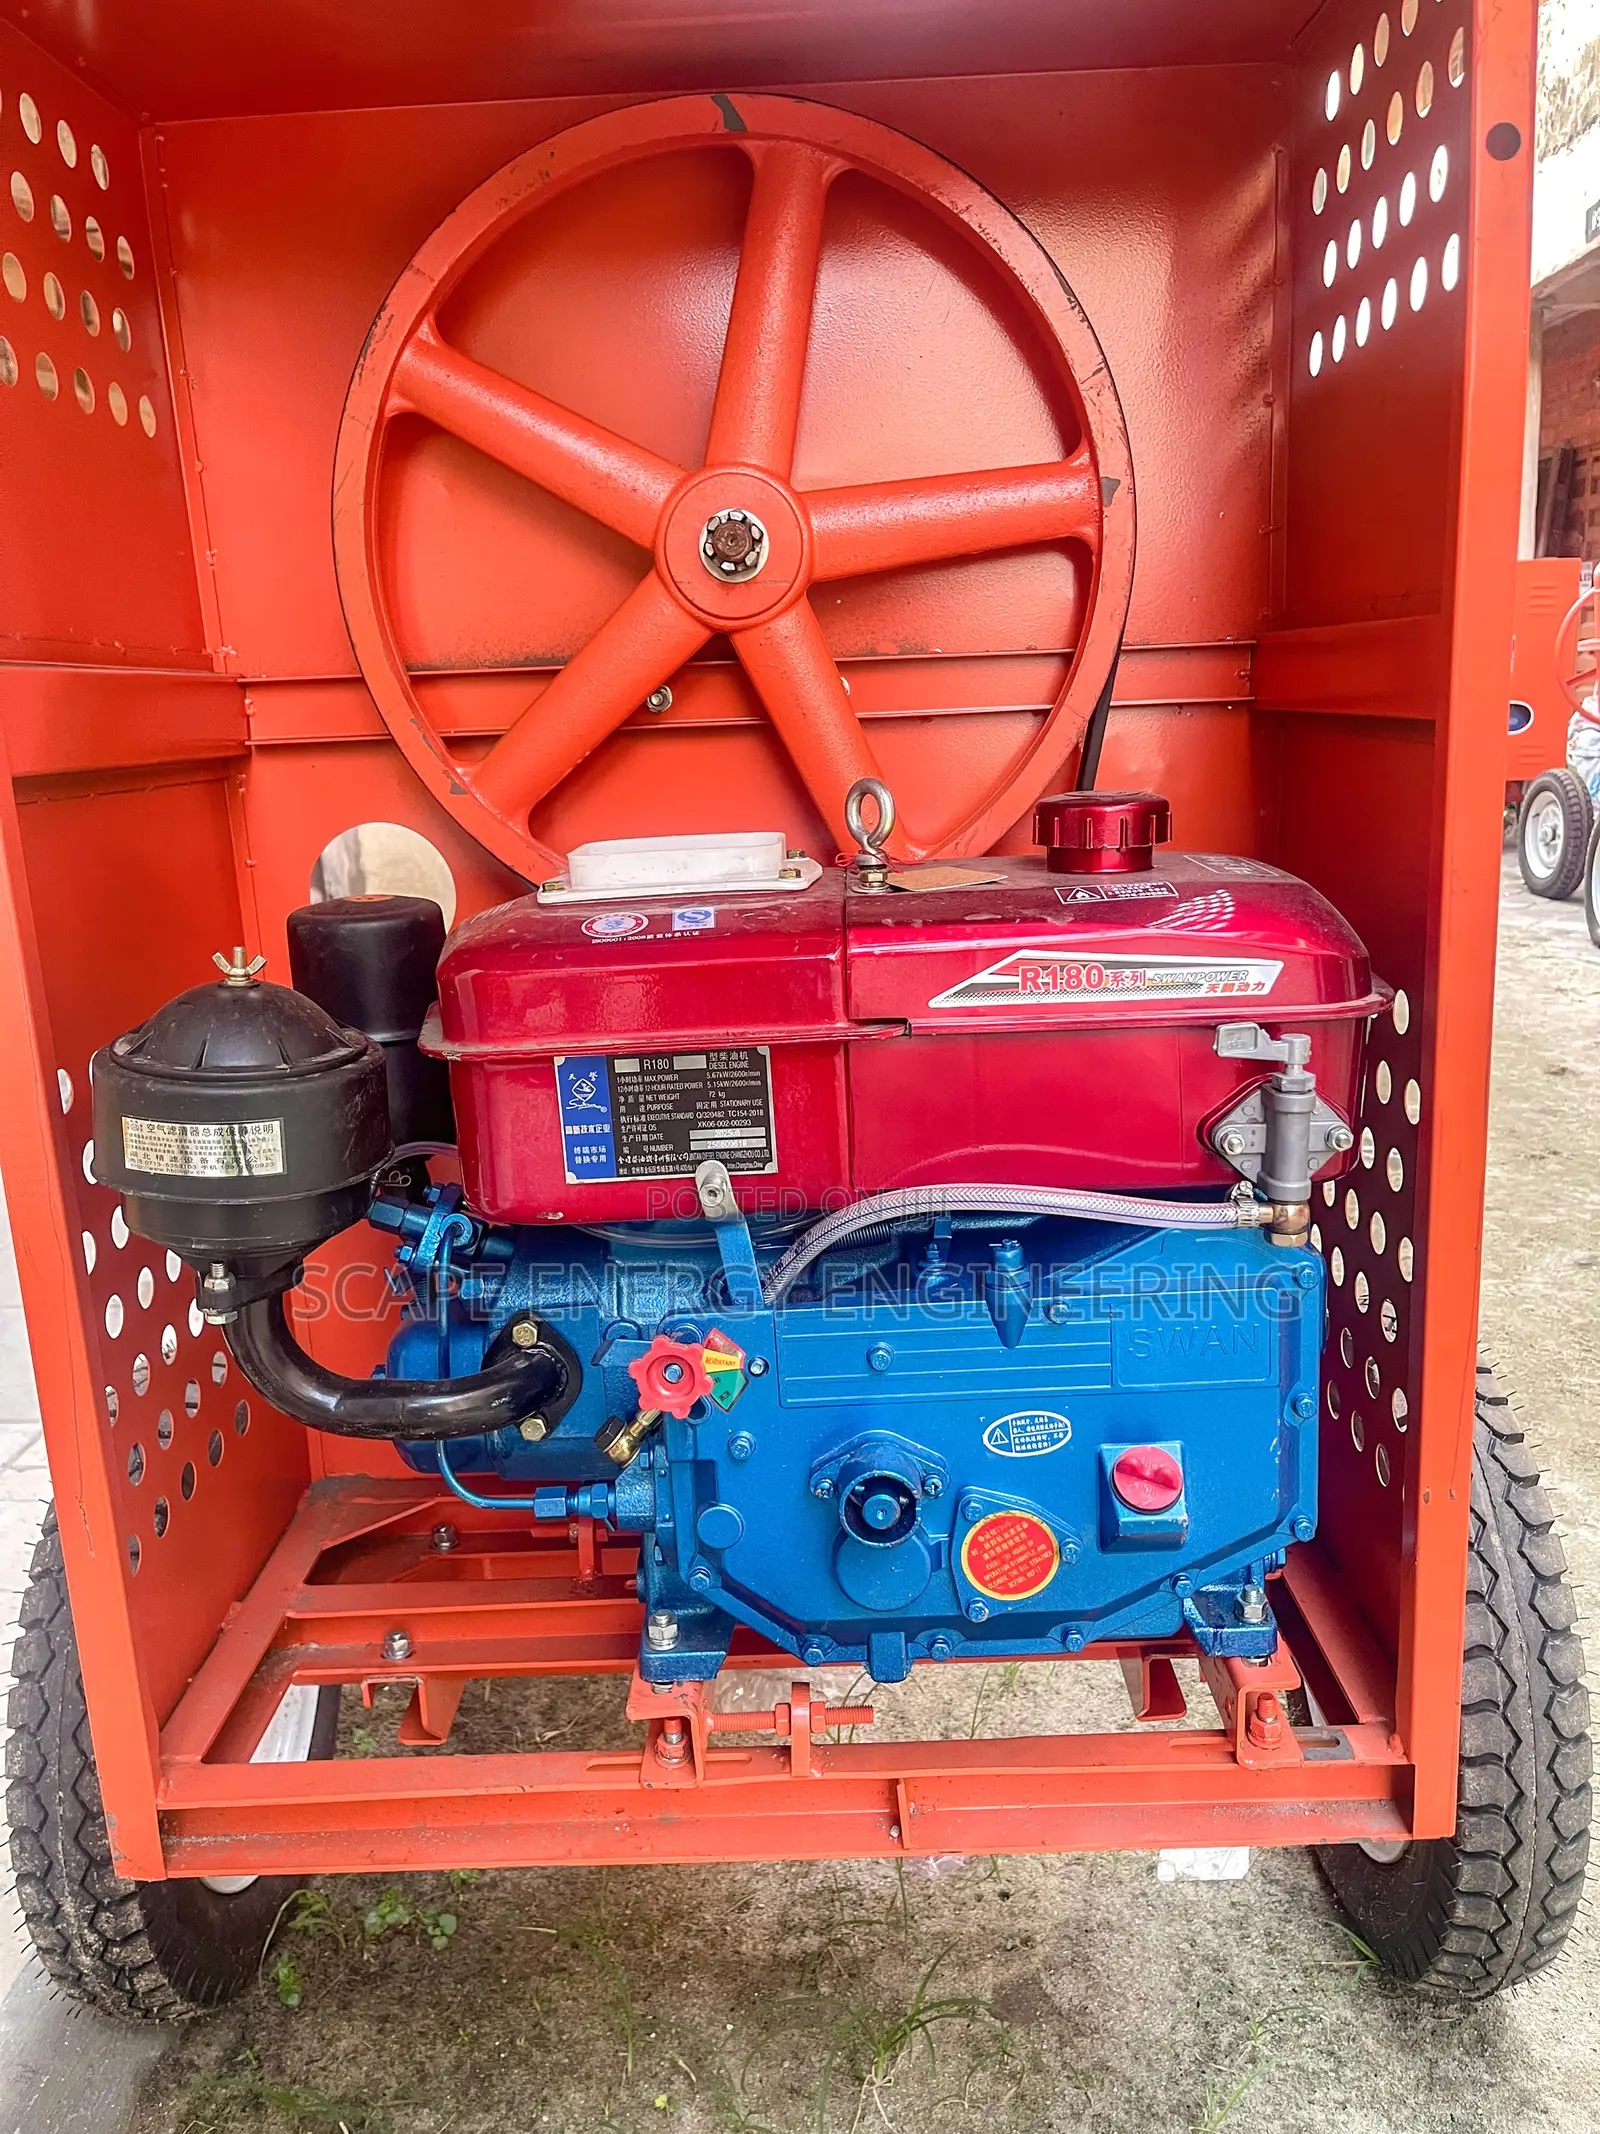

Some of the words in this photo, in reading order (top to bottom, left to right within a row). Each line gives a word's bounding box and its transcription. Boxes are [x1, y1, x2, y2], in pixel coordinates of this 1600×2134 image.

[1019, 963, 1105, 992] R180
[1109, 970, 1148, 988] 系列
[1152, 970, 1249, 984] SWANPOWER
[643, 1058, 670, 1070] R180
[708, 1062, 728, 1070] DIESEL
[728, 1061, 750, 1069] ENGINE
[657, 1074, 679, 1082] POWER
[667, 1083, 684, 1091] RATED
[684, 1082, 703, 1090] POWER
[658, 1093, 680, 1101] WEIGHT
[718, 1091, 726, 1099] kg
[646, 1103, 674, 1111] PURPOSE
[720, 1099, 752, 1108] STATIONARY
[752, 1098, 763, 1106] USE
[671, 1112, 695, 1120] STANDARD
[146, 1123, 275, 1138] 空气滤清器总成保说明
[648, 1133, 665, 1141] DATE
[649, 1144, 674, 1152] NUMBER
[1128, 1323, 1260, 1359] SWAN
[984, 1564, 1010, 1581] OPERATION
[1037, 1544, 1047, 1552] AND
[1009, 1569, 1019, 1577] THE
[1019, 1563, 1029, 1572] OIL
